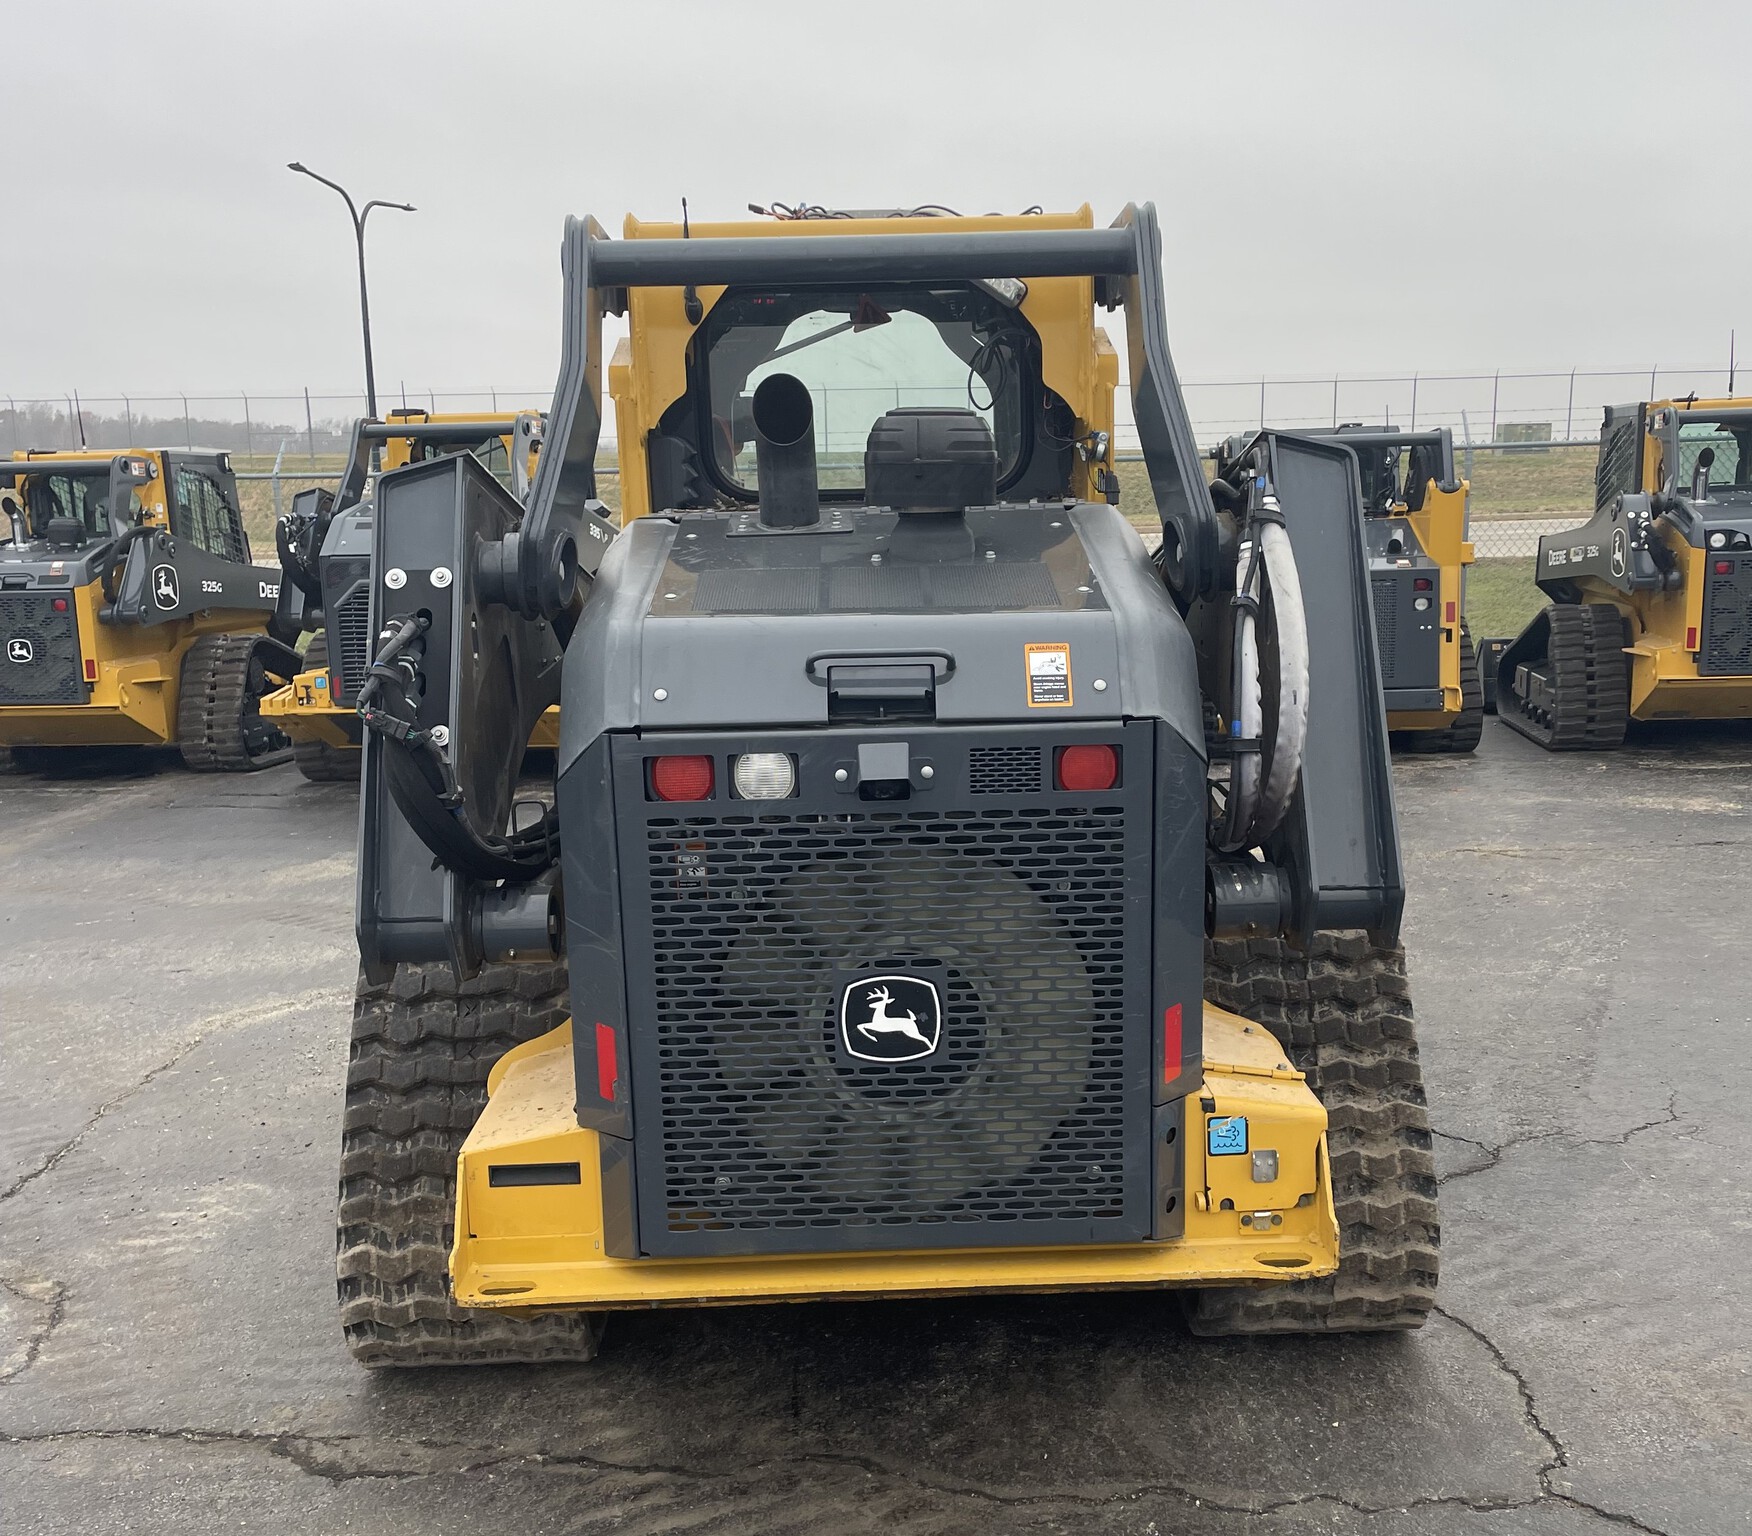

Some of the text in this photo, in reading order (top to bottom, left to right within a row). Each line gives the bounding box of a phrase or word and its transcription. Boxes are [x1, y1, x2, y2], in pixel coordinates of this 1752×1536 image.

[1548, 549, 1567, 566] DEERE
[201, 580, 279, 598] 325G DEE
